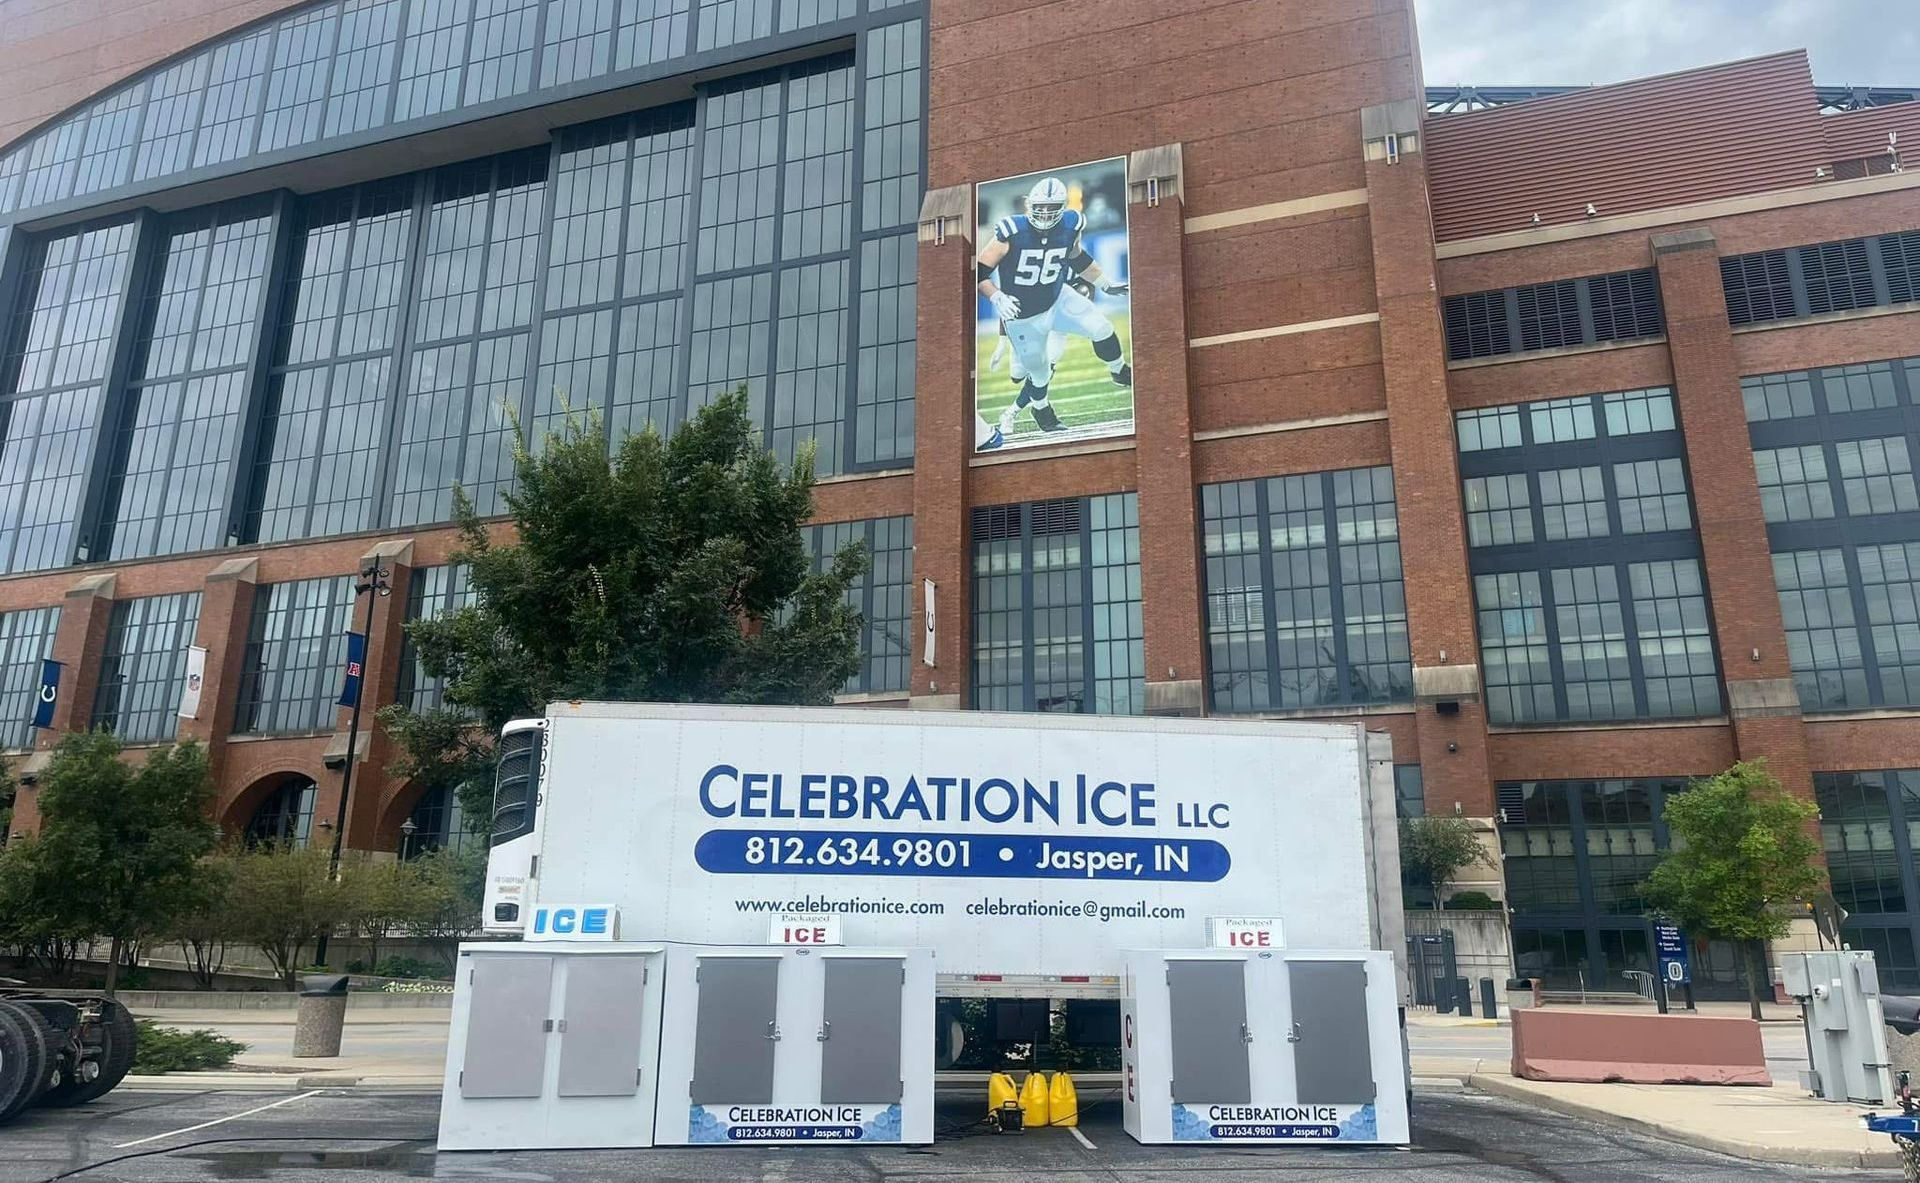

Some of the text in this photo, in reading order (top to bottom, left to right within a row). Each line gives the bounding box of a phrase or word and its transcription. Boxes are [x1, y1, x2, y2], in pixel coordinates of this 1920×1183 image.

[1014, 247, 1068, 286] 56
[699, 764, 1230, 829] CELEBRATION ICE LLC
[745, 836, 1189, 878] 812.634.9801 Jasper, IN
[735, 895, 944, 915] www.celebrationice.com
[966, 897, 1185, 922] celebrationice@gmail.com
[534, 908, 608, 934] ICE
[782, 914, 830, 923] Packaged
[1226, 919, 1273, 927] Packaged
[784, 928, 826, 943] ICE
[1230, 931, 1271, 947] ICE
[729, 1107, 861, 1122] CELEBRATION ICE
[1209, 1105, 1337, 1121] CELEBRATION ICE
[735, 1128, 855, 1140] 812.634.9801 Jasper, IN
[1217, 1126, 1333, 1138] 812.634.9801 Jasper, IN
